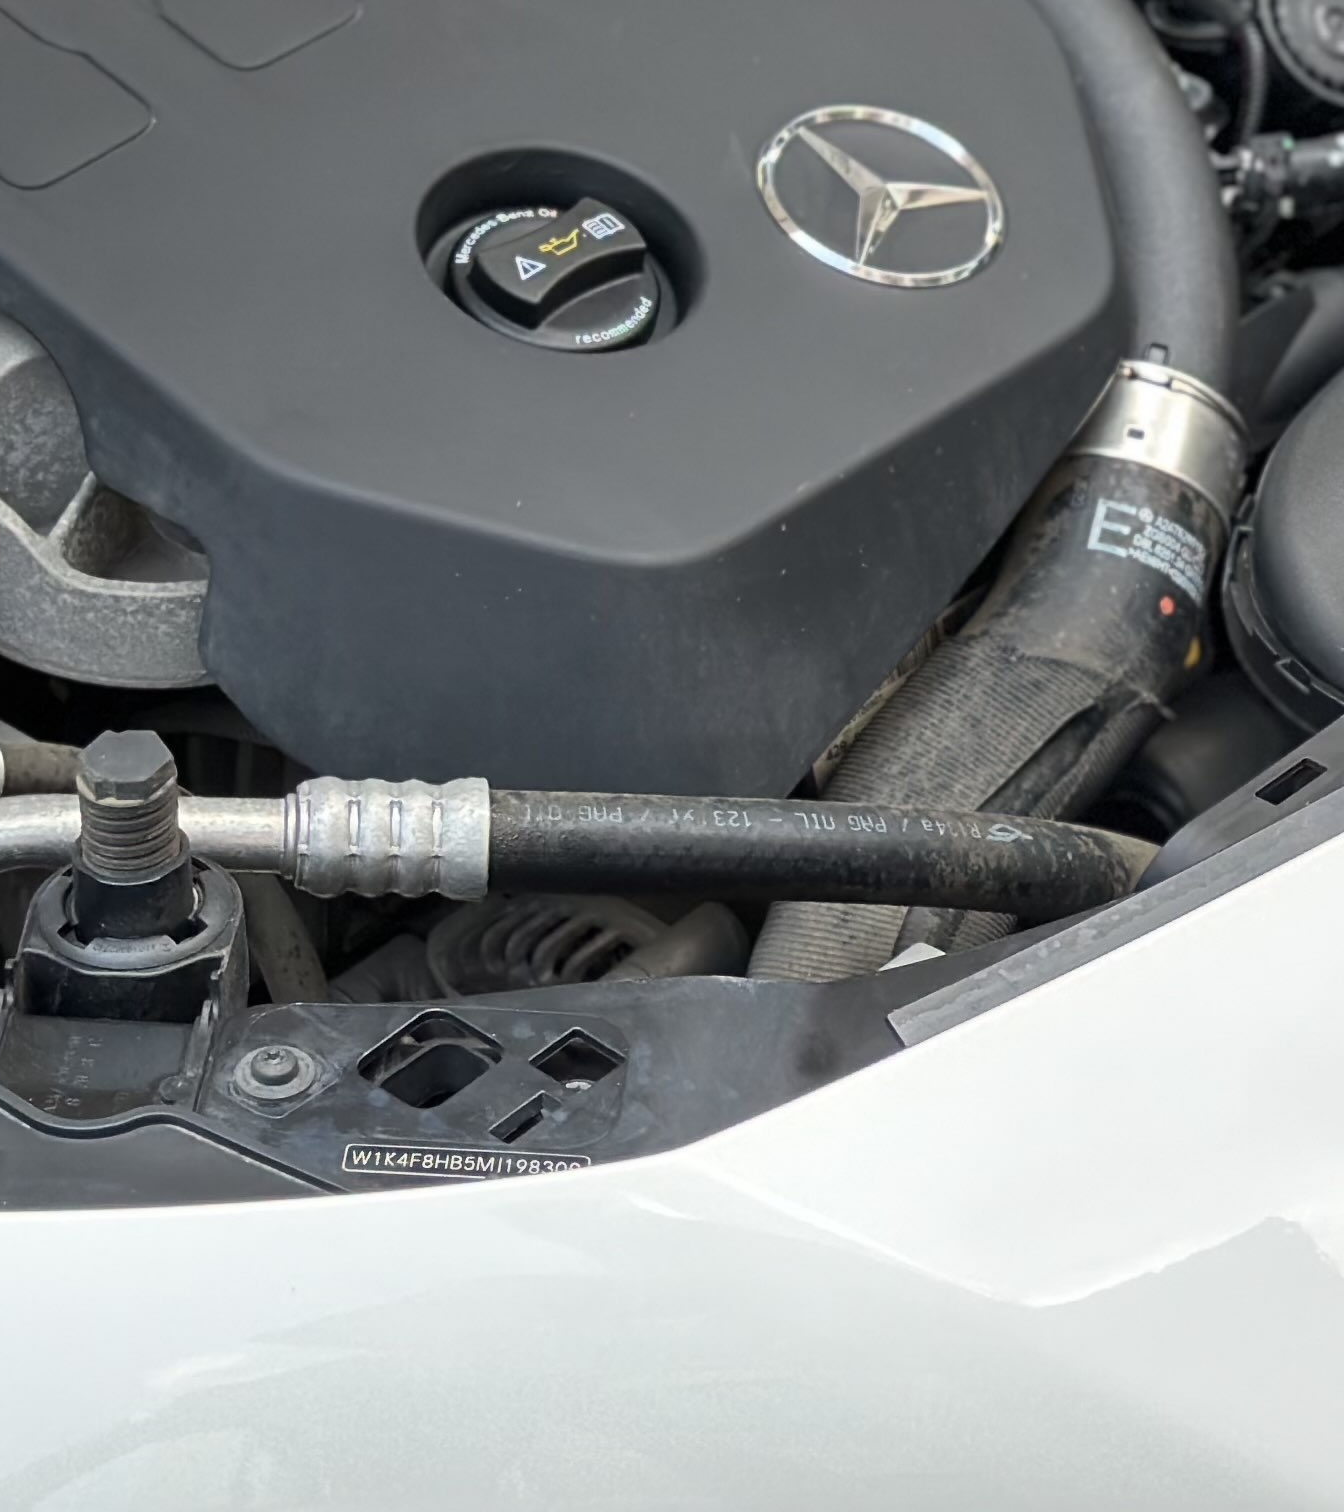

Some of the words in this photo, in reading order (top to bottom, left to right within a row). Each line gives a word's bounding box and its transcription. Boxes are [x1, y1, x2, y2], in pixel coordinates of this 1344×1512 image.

[575, 296, 653, 345] recommended
[578, 804, 624, 824] PAG
[847, 815, 888, 834] PAG
